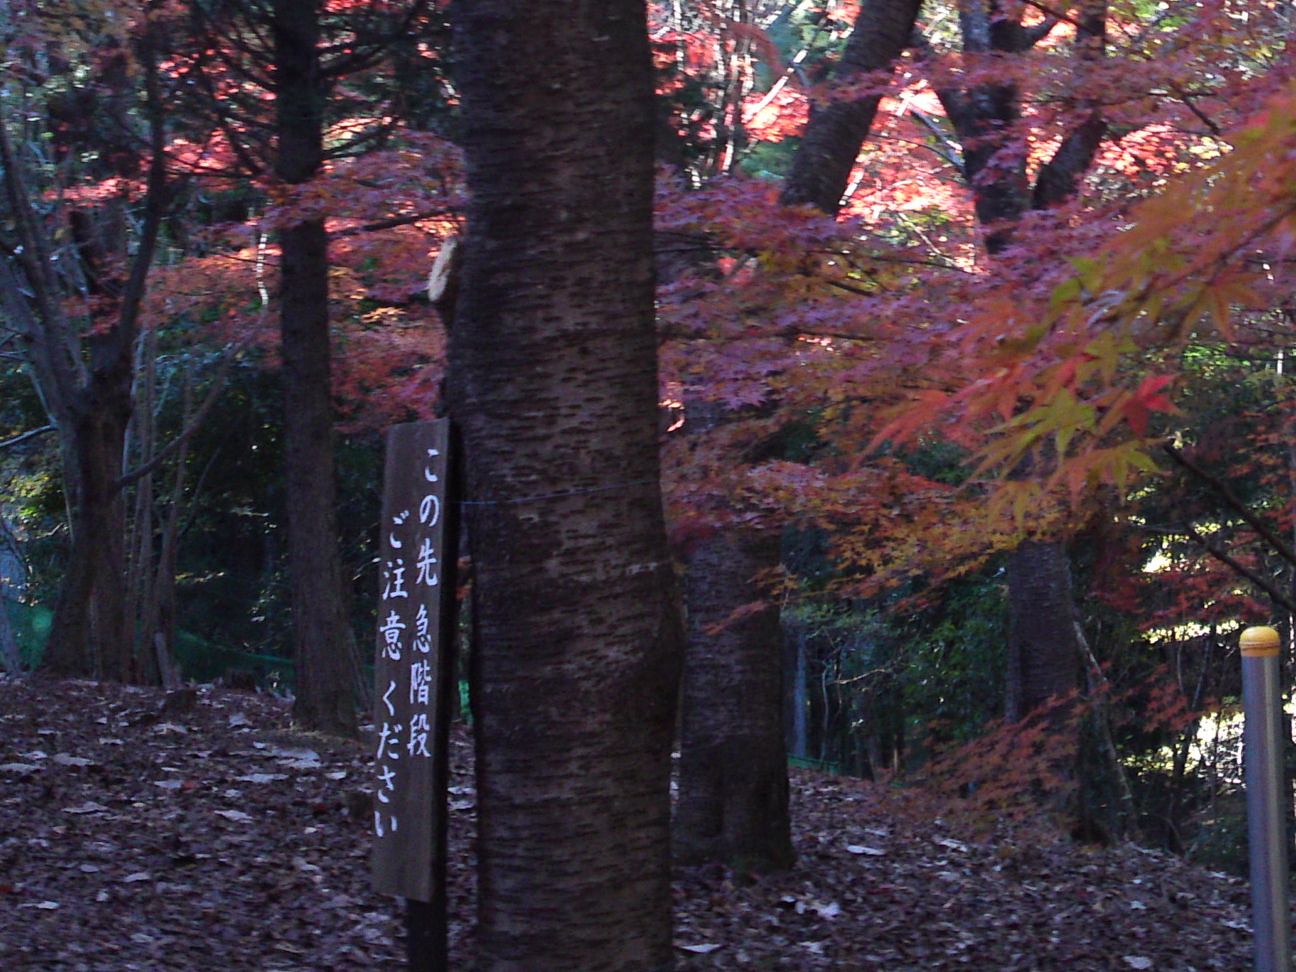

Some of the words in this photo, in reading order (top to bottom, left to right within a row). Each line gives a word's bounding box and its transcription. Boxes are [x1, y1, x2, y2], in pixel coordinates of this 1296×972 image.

[374, 509, 410, 838] ご注意ください
[406, 448, 440, 758] この先急階段
